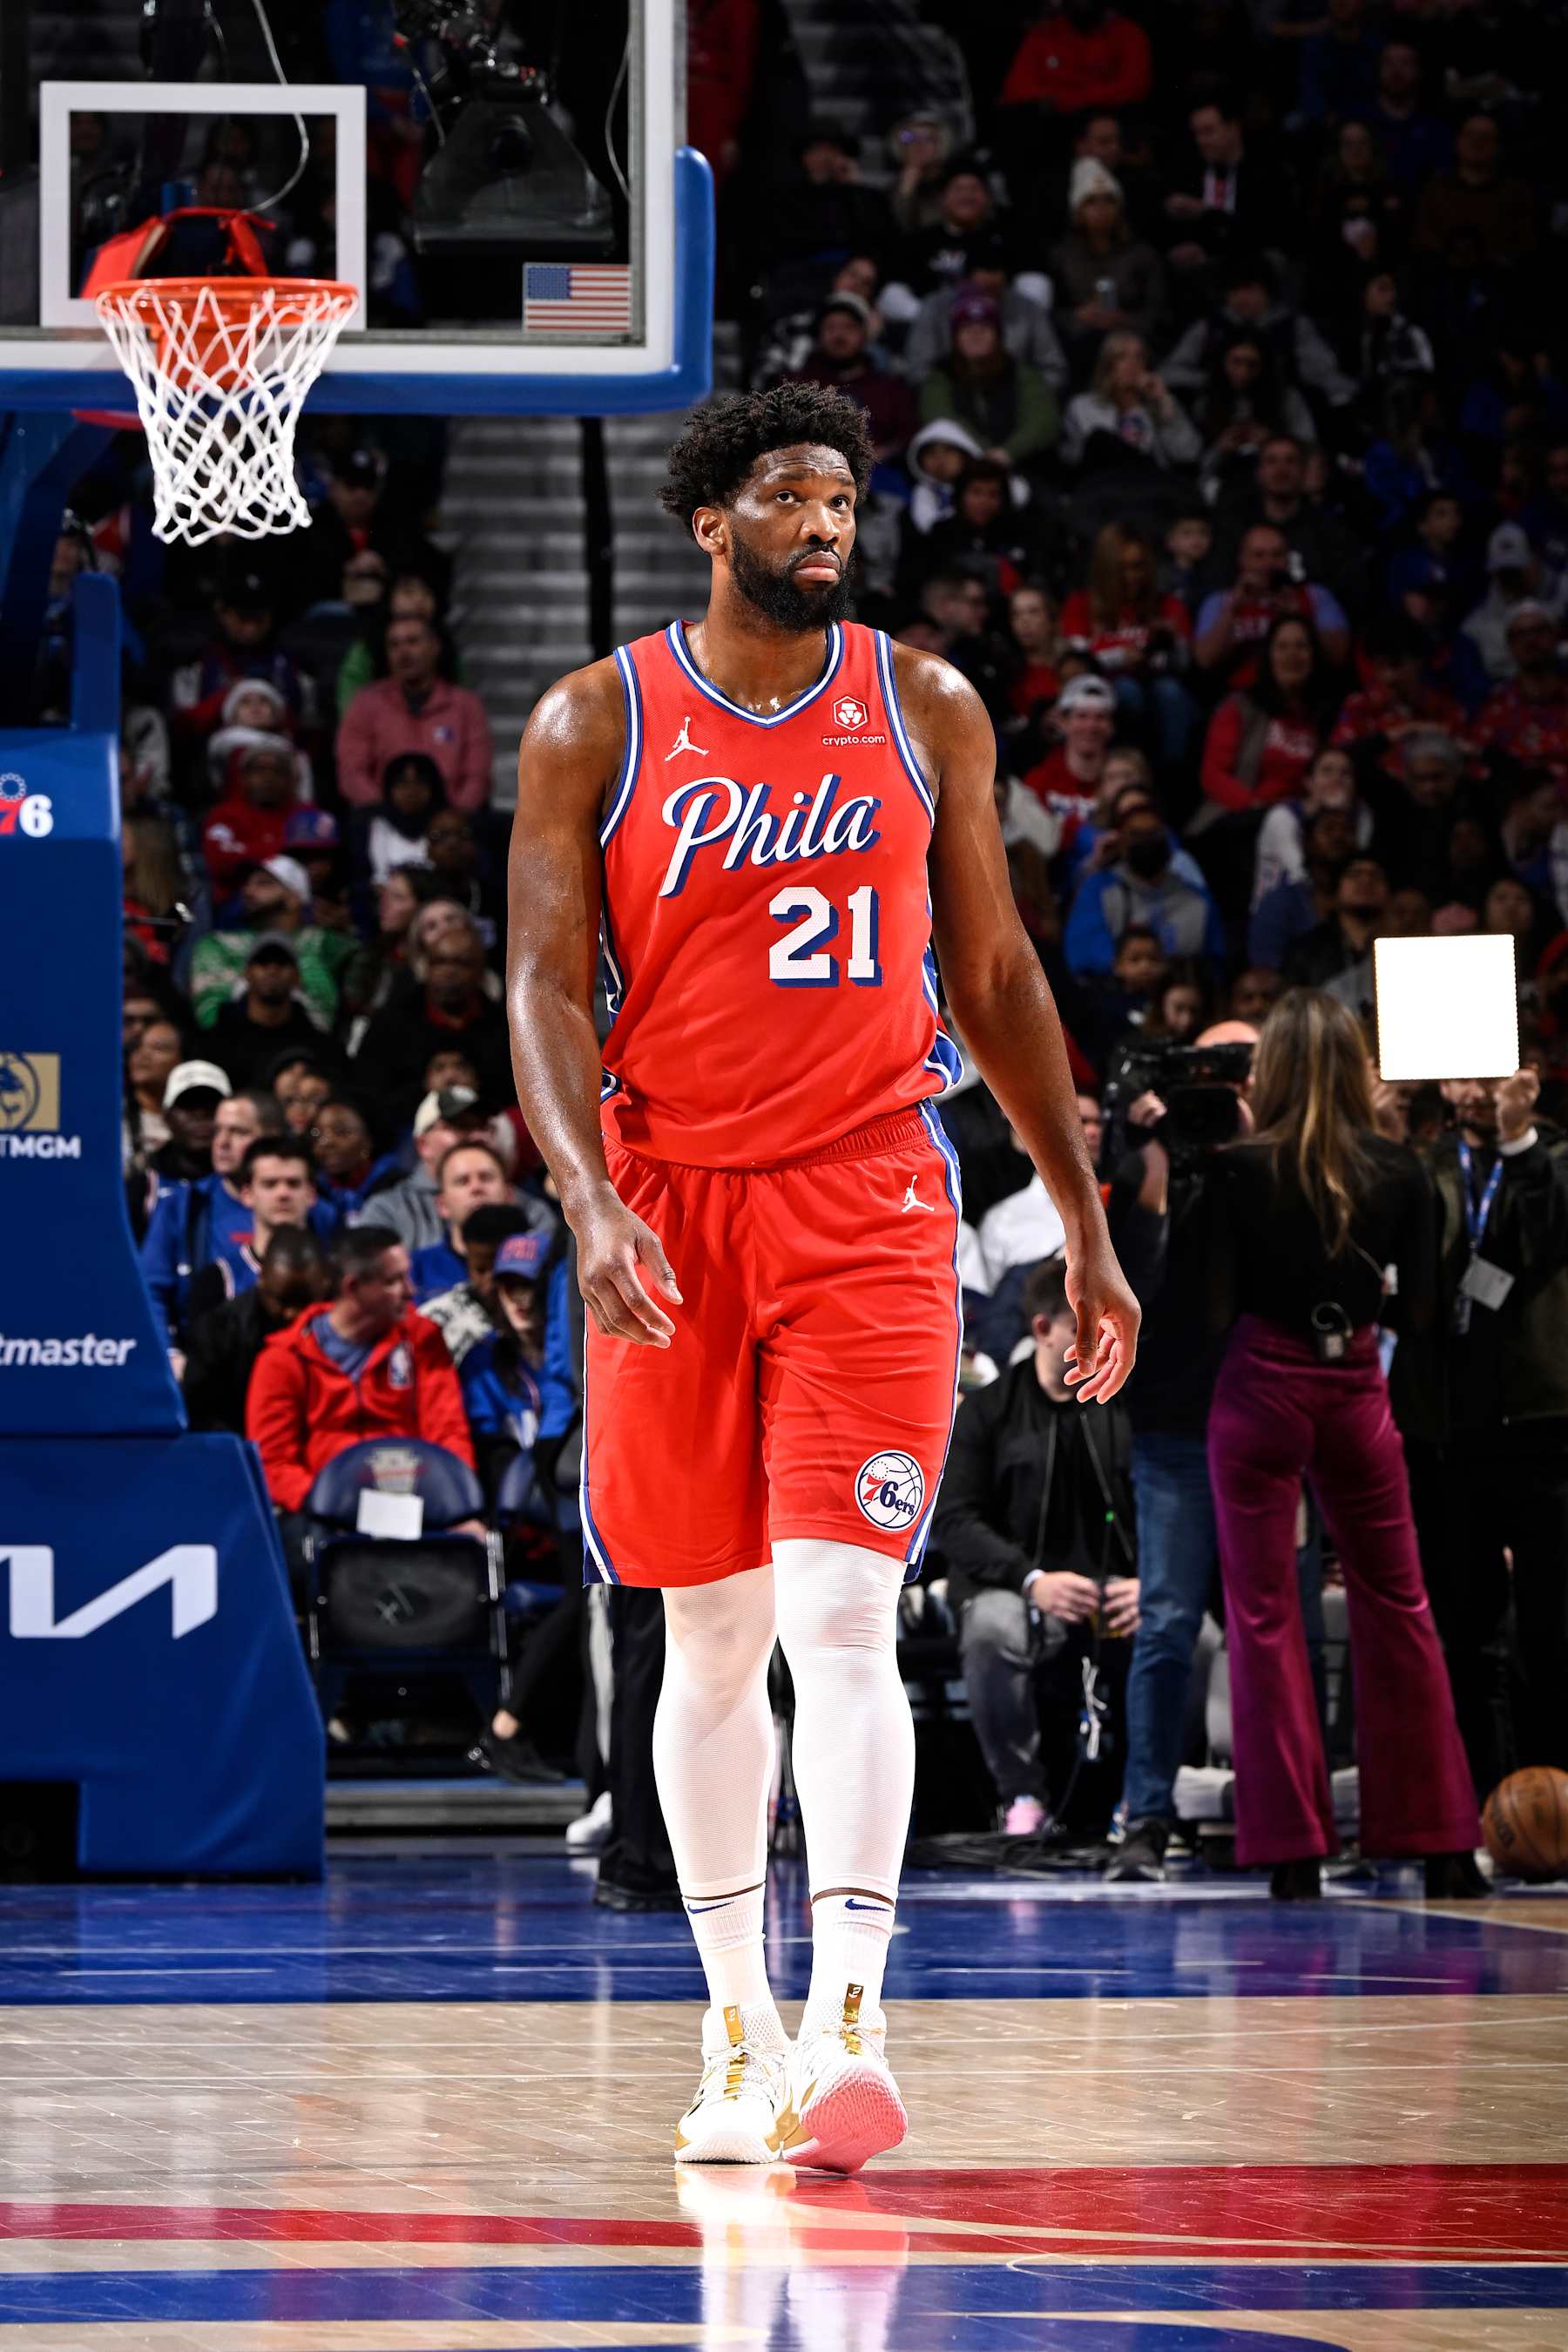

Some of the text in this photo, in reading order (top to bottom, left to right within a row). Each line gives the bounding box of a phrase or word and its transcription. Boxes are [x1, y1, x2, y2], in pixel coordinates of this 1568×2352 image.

[822, 735, 885, 747] crypto.com
[0, 794, 54, 838] 76
[659, 774, 882, 898] Phila
[769, 885, 882, 987] 21
